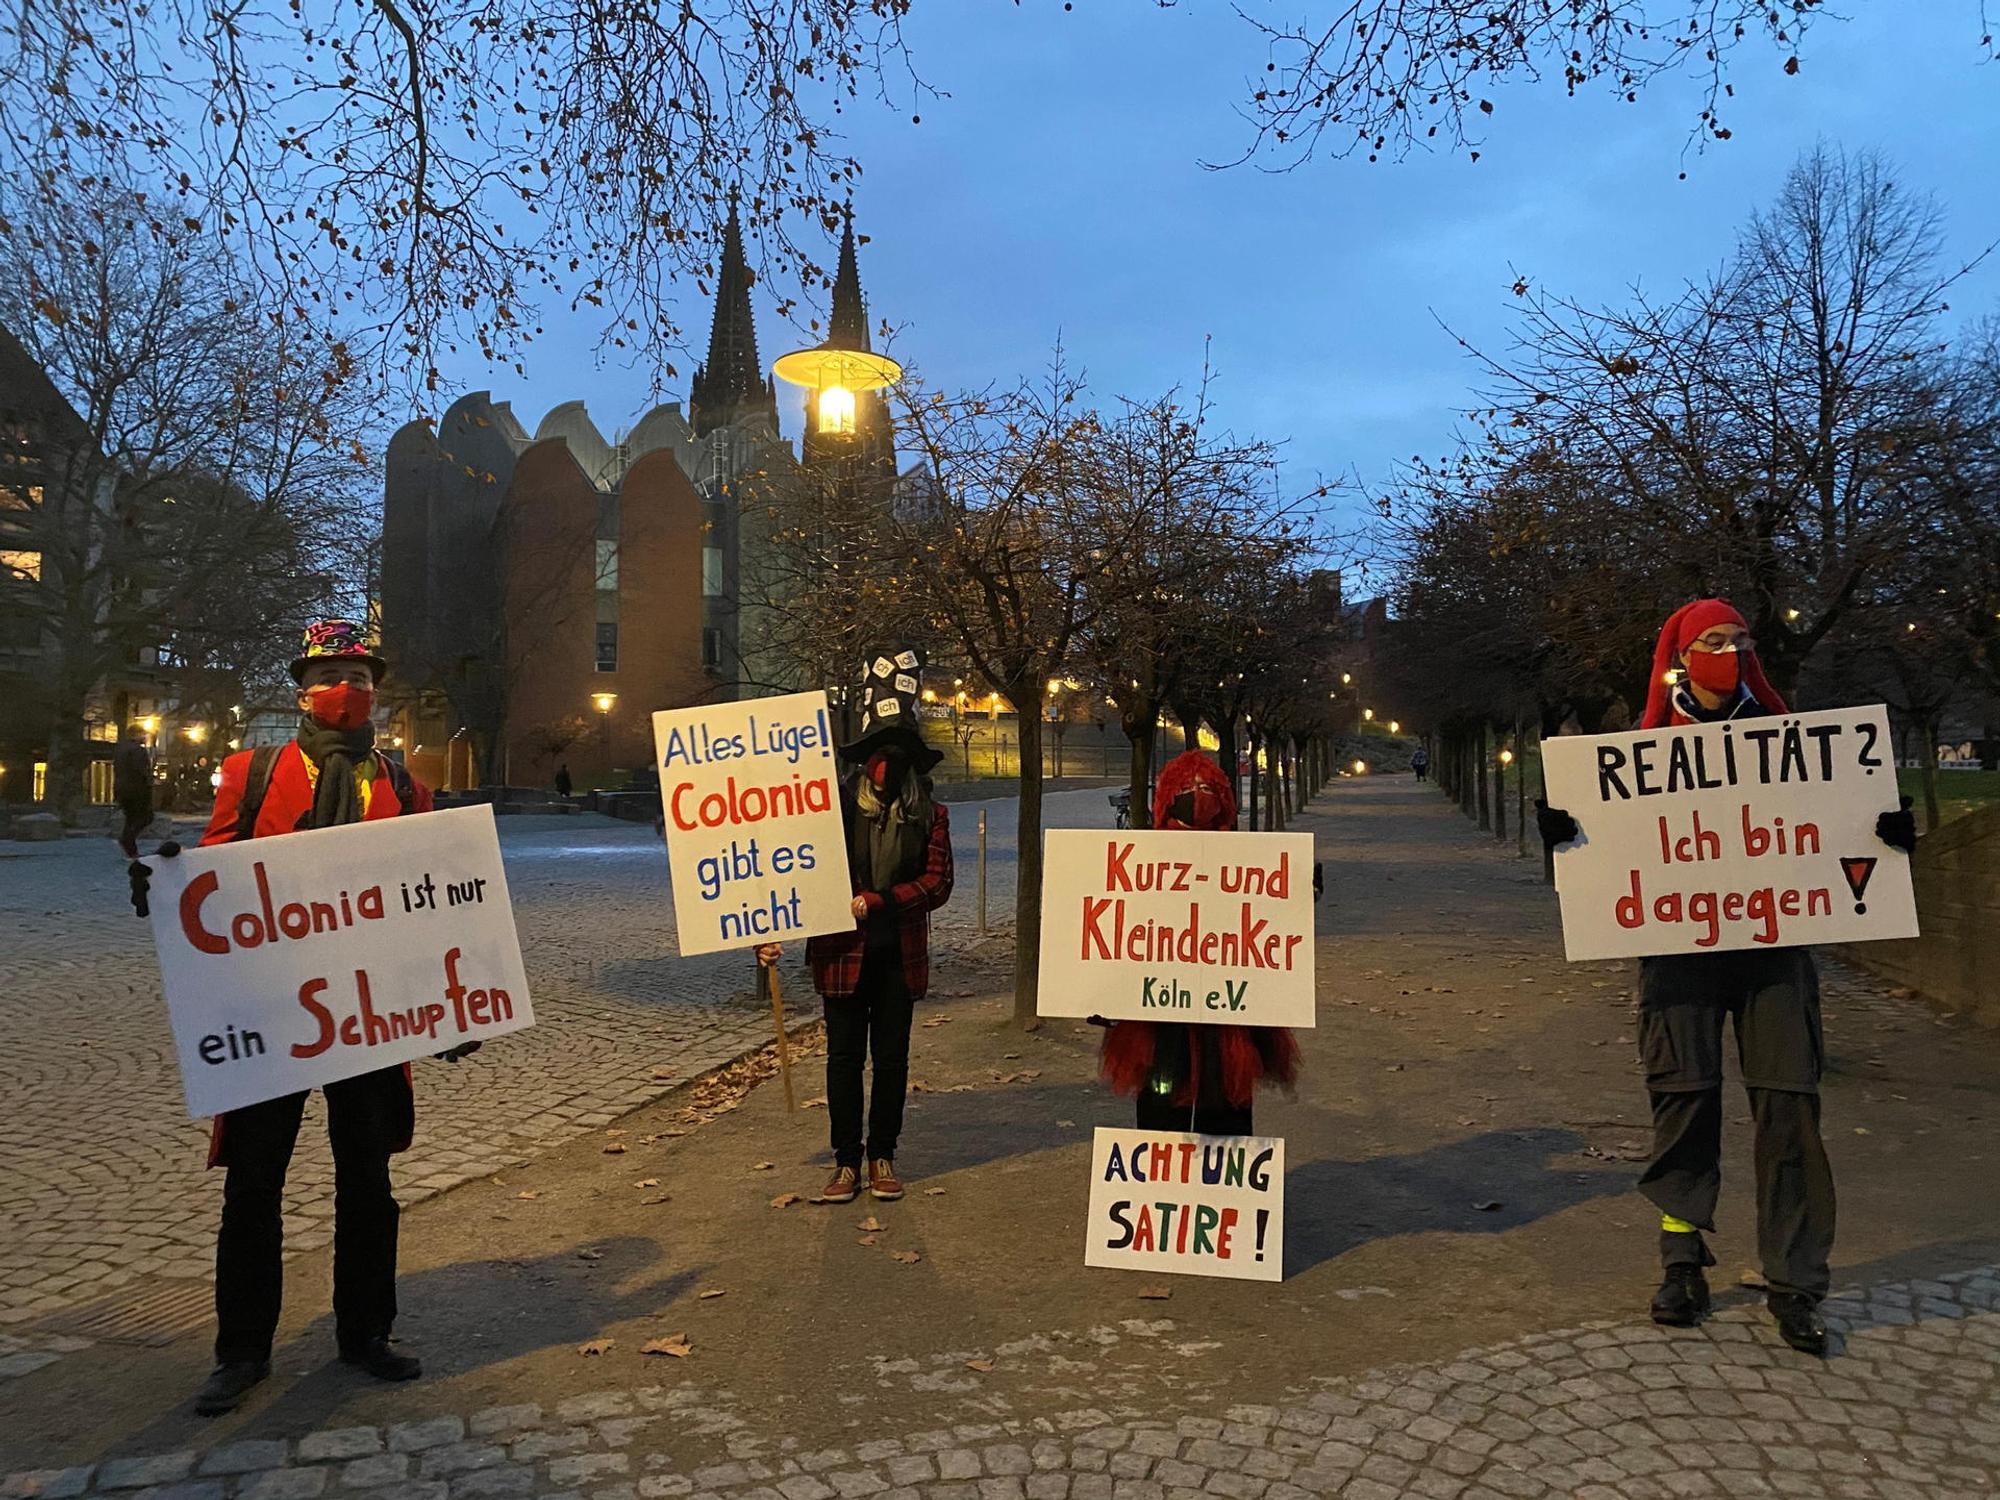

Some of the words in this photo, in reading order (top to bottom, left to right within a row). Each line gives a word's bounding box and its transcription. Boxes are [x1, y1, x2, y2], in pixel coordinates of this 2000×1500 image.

[879, 700, 897, 713] ich
[663, 722, 746, 768] Alles
[750, 709, 830, 764] Lüge!
[671, 773, 832, 832] Colonia
[1658, 810, 1720, 864] Ich
[1741, 804, 1820, 857] bin
[697, 838, 764, 901] gibt
[772, 843, 816, 874] es
[1106, 841, 1209, 893] Kurz-
[1220, 852, 1289, 899] und
[179, 861, 385, 954] Colonia
[401, 873, 435, 912] ist
[447, 878, 486, 906] nur
[720, 887, 803, 940] nicht
[199, 1025, 265, 1065] ein
[290, 947, 513, 1058] Schnupfen
[1142, 977, 1191, 1009] Köln
[1205, 980, 1248, 1012] e.V.
[1104, 1142, 1272, 1192] ACHTUNG
